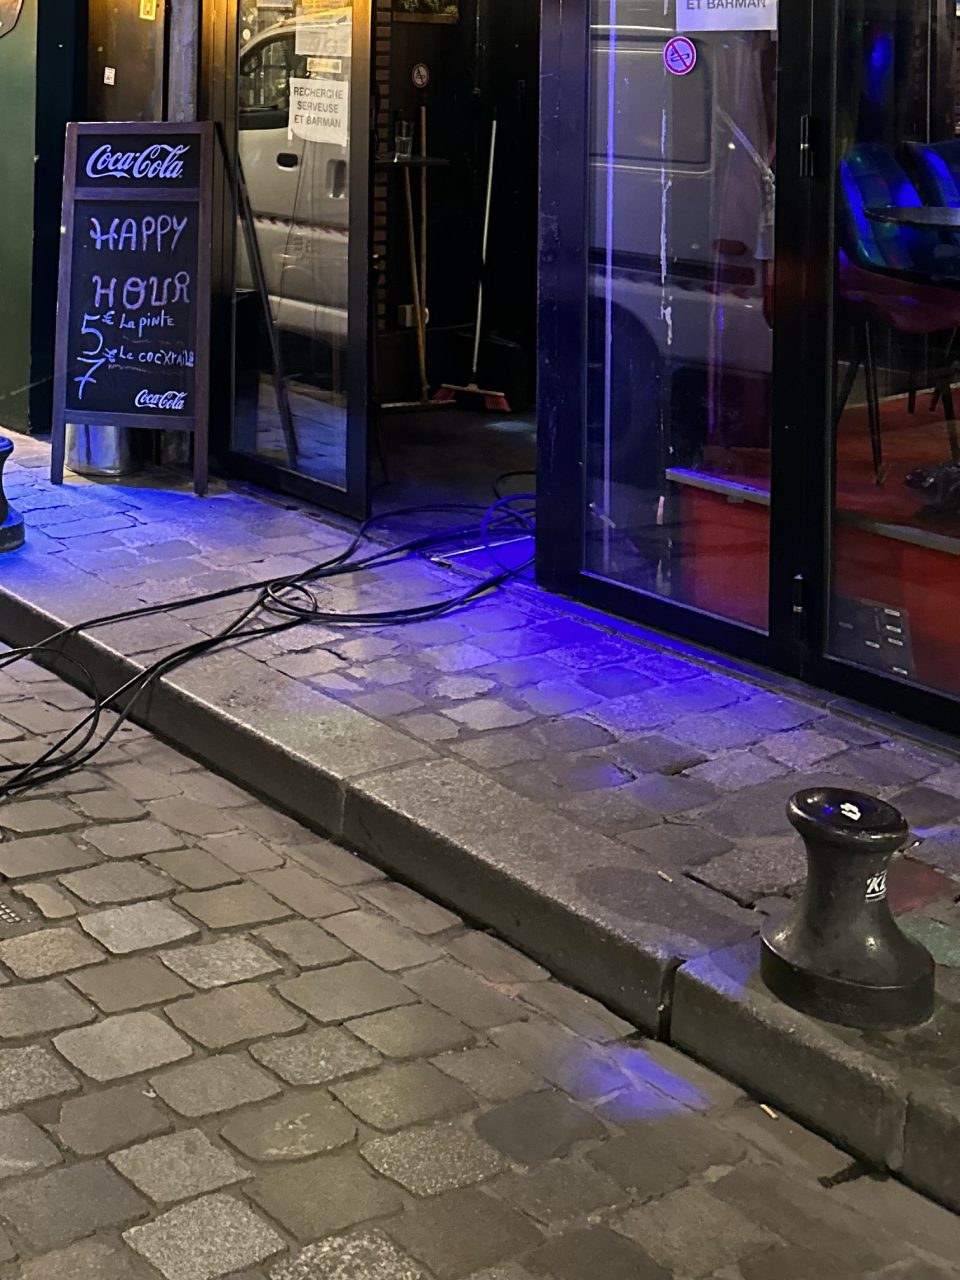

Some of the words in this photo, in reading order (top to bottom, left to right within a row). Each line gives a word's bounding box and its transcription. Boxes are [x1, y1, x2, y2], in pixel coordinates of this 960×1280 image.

[293, 86, 344, 100] RECHERCHE
[296, 100, 339, 114] SERVEUSE
[294, 115, 304, 124] ET
[305, 116, 341, 129] BARMAN
[85, 144, 190, 179] Coca-Cola
[89, 214, 188, 252] HAPPY
[91, 271, 190, 310] HOUR
